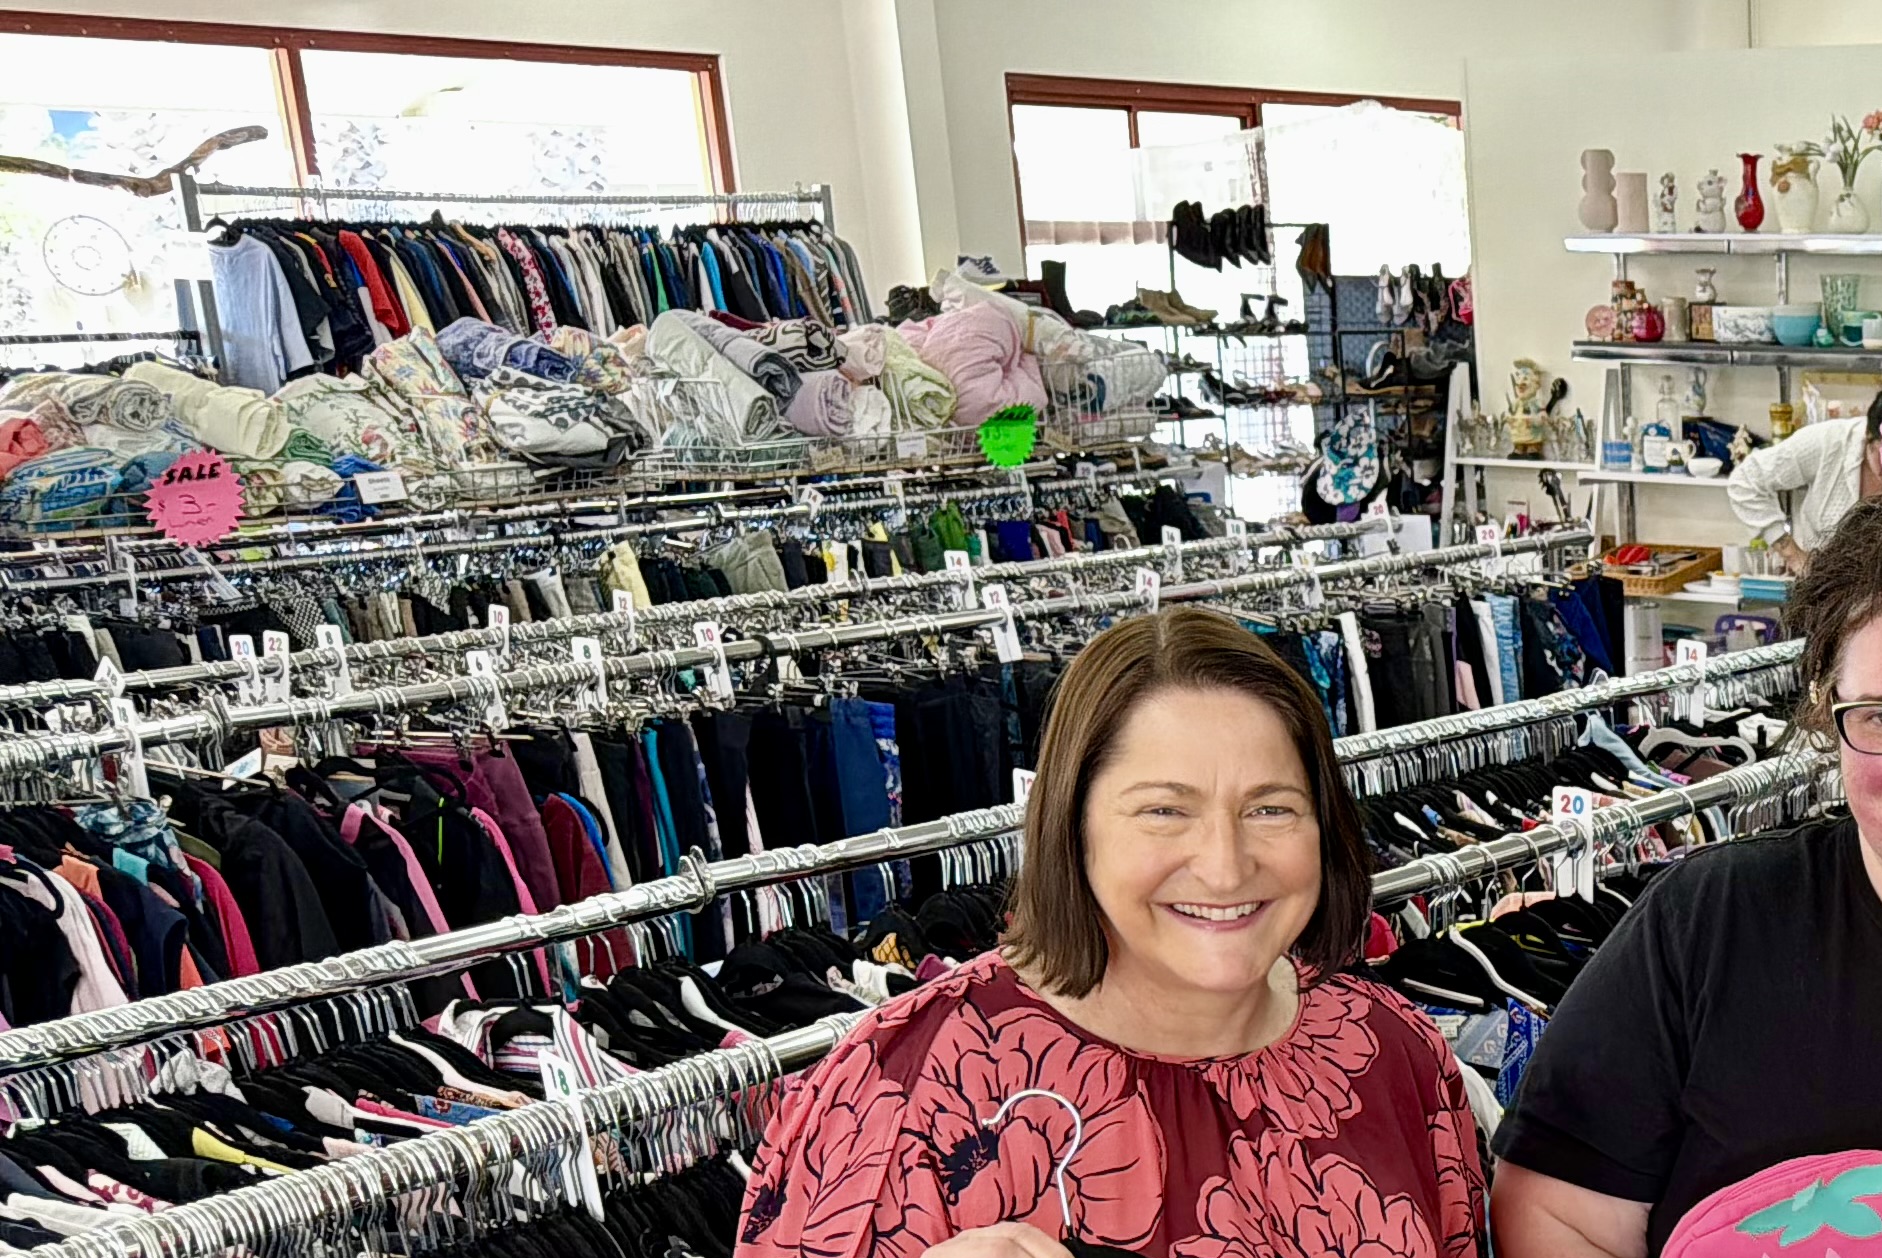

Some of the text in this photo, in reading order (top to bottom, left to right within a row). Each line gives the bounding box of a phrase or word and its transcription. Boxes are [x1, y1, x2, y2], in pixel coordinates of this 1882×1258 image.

[163, 462, 221, 485] SALE
[1481, 530, 1495, 541] 20
[950, 555, 962, 568] 14
[493, 609, 503, 624] 10
[702, 628, 714, 642] 10
[234, 640, 250, 656] 20
[268, 636, 283, 652] 22
[583, 644, 592, 659] 8
[1685, 646, 1698, 662] 14
[475, 656, 482, 671] 6
[1561, 794, 1584, 814] 20
[547, 1062, 570, 1096] 18
